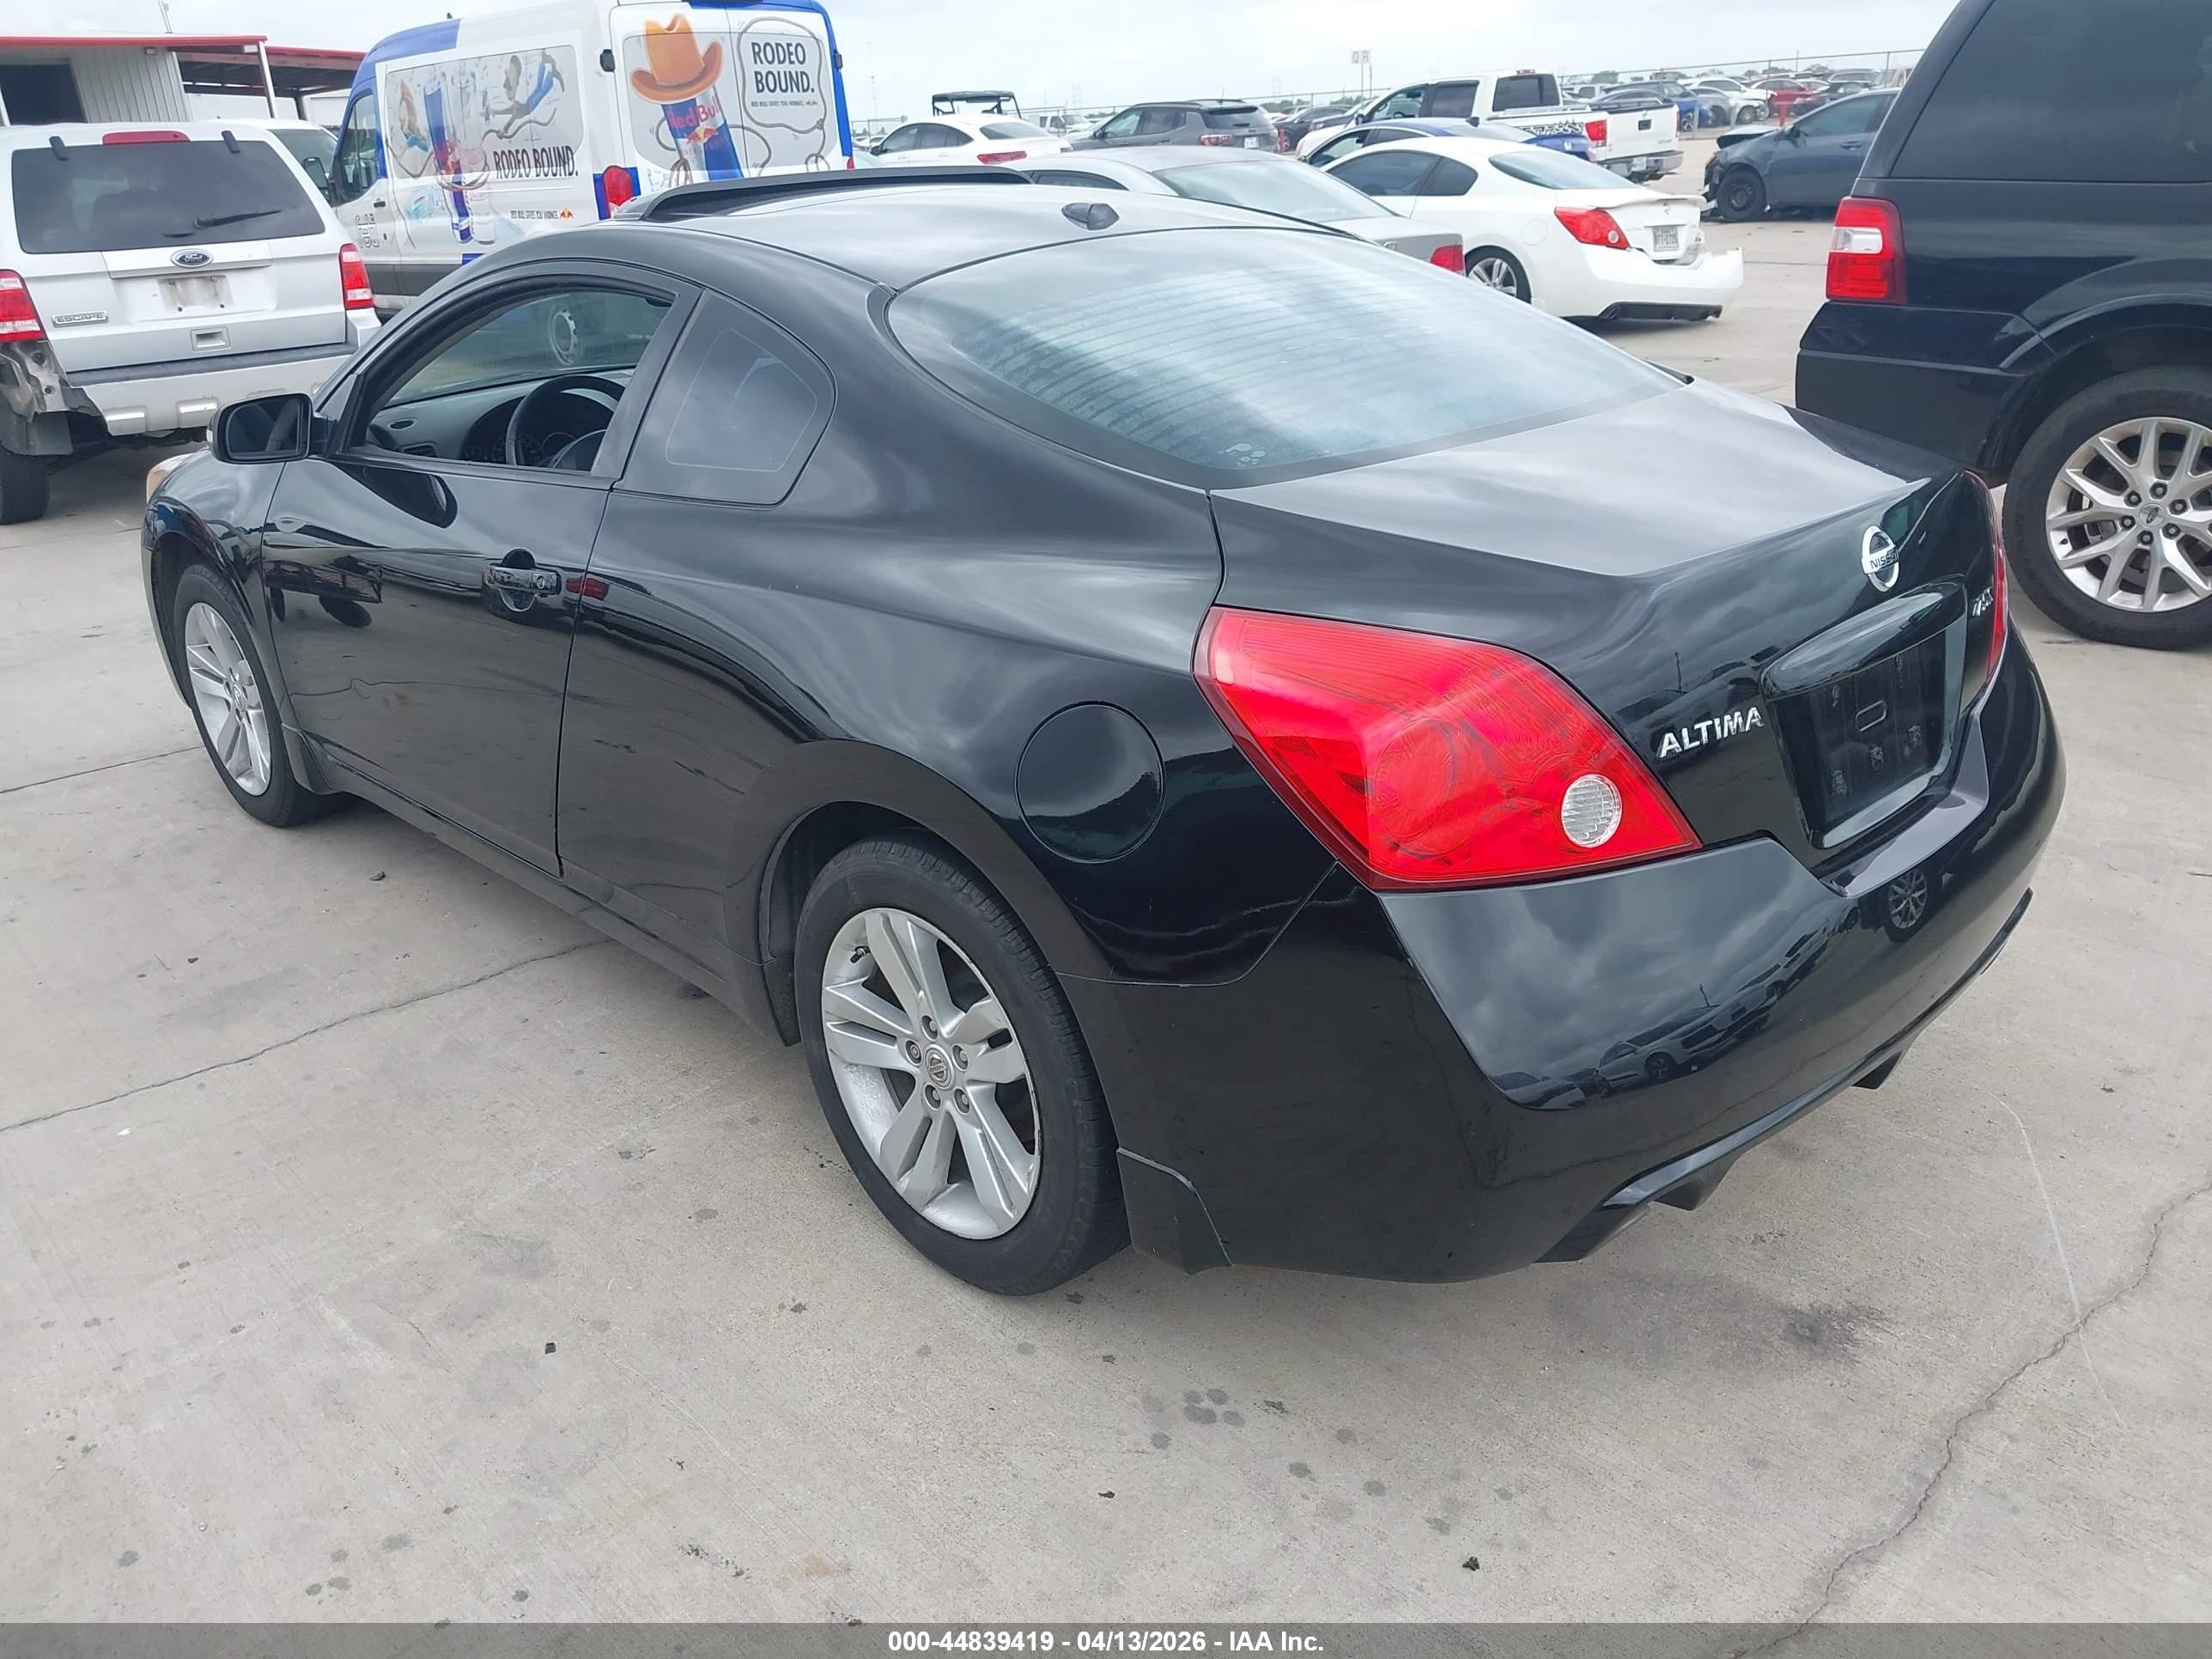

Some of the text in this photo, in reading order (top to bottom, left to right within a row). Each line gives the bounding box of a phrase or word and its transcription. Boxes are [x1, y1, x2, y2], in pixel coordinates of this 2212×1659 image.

[751, 41, 806, 65] RODEO
[754, 70, 815, 94] BOUND.
[667, 94, 722, 129] Red Bull
[493, 148, 532, 179] RODEO
[532, 145, 579, 178] BOUND.
[54, 311, 105, 323] ESCAPE
[1656, 706, 1765, 759] ALTIMA
